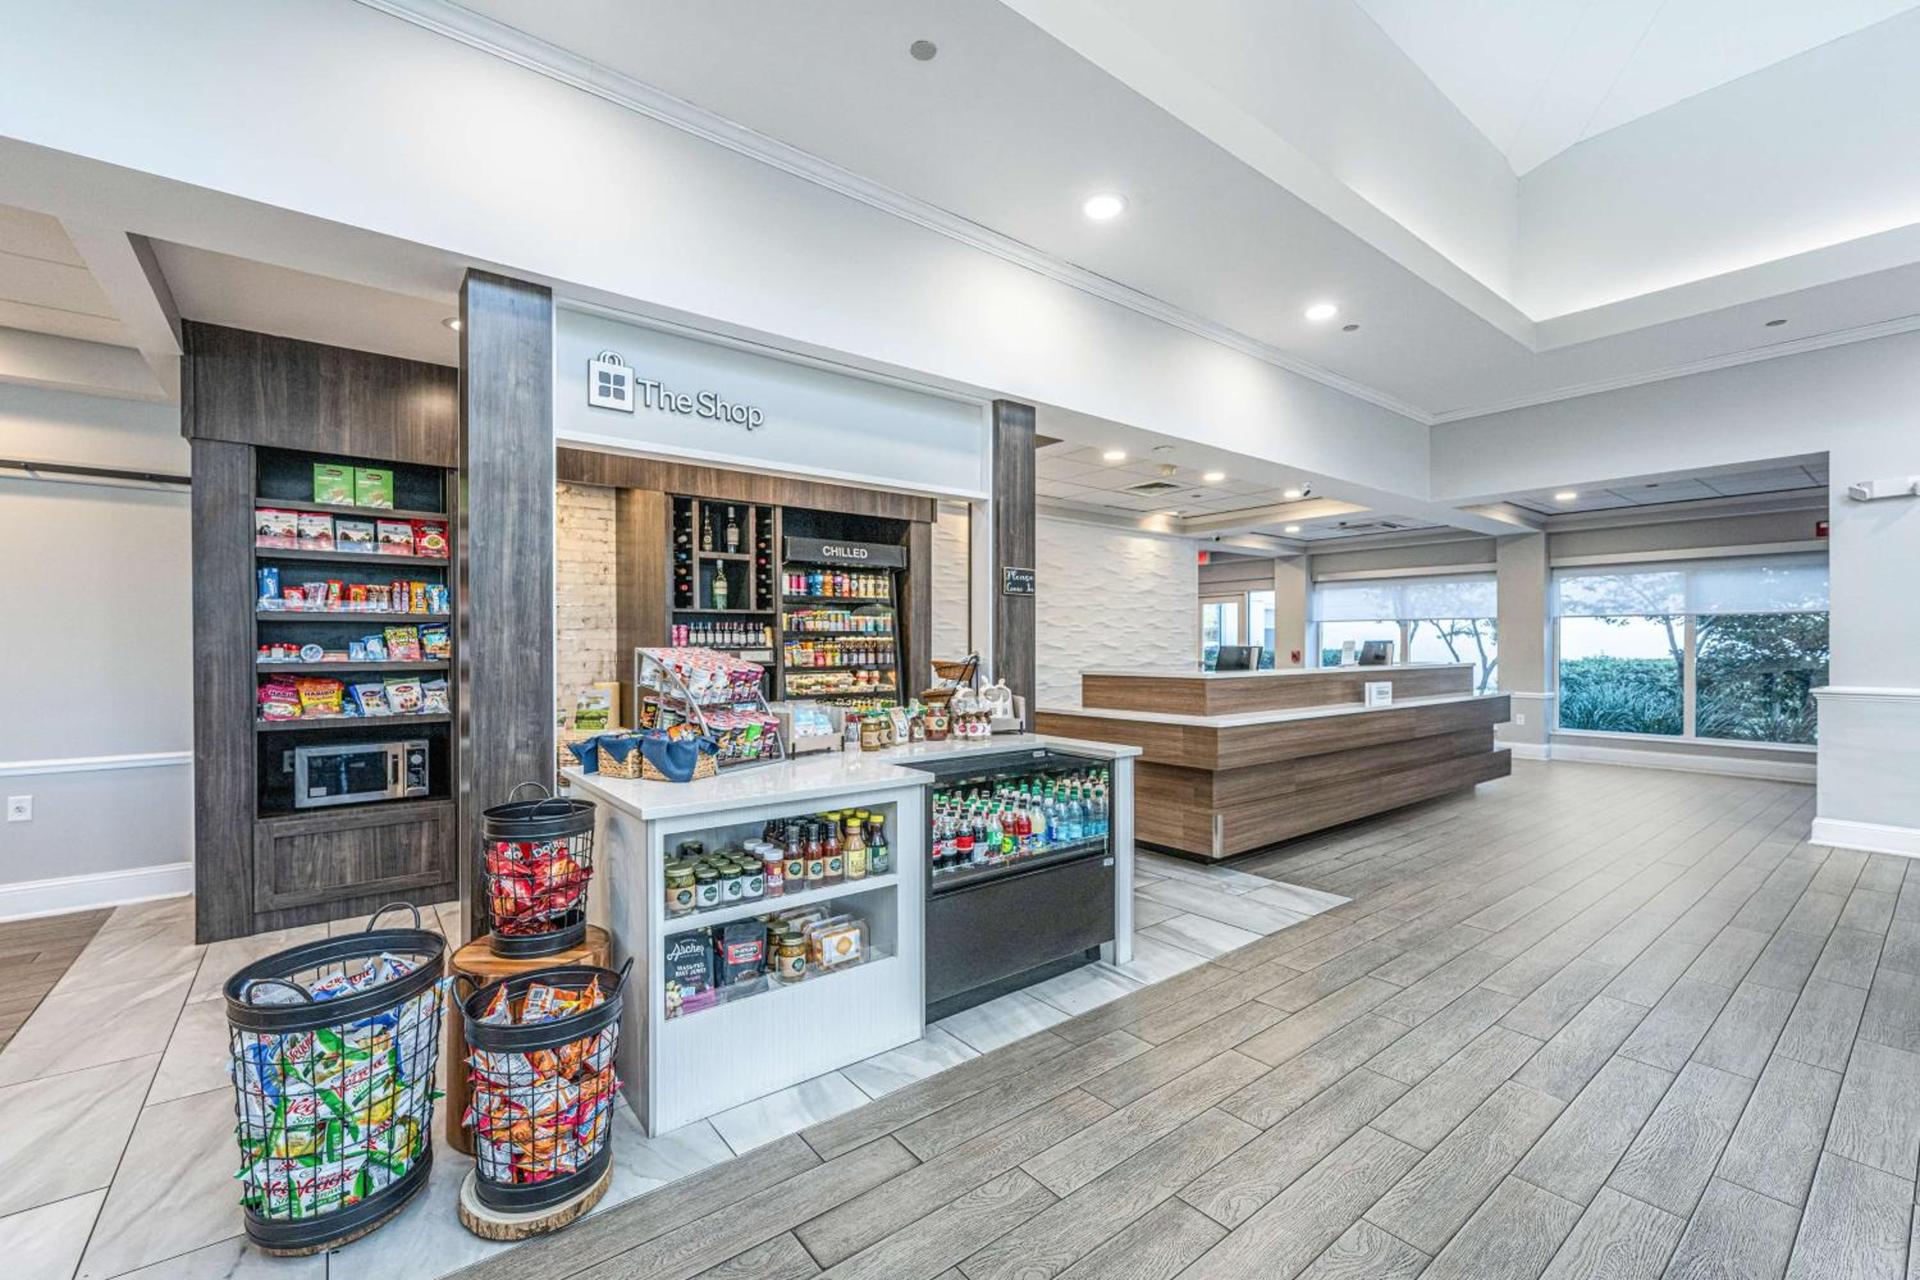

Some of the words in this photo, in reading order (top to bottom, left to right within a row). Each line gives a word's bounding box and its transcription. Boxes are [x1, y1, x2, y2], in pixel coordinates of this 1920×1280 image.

[636, 377, 693, 414] The
[696, 391, 765, 431] Shop
[822, 545, 868, 559] CHILLED
